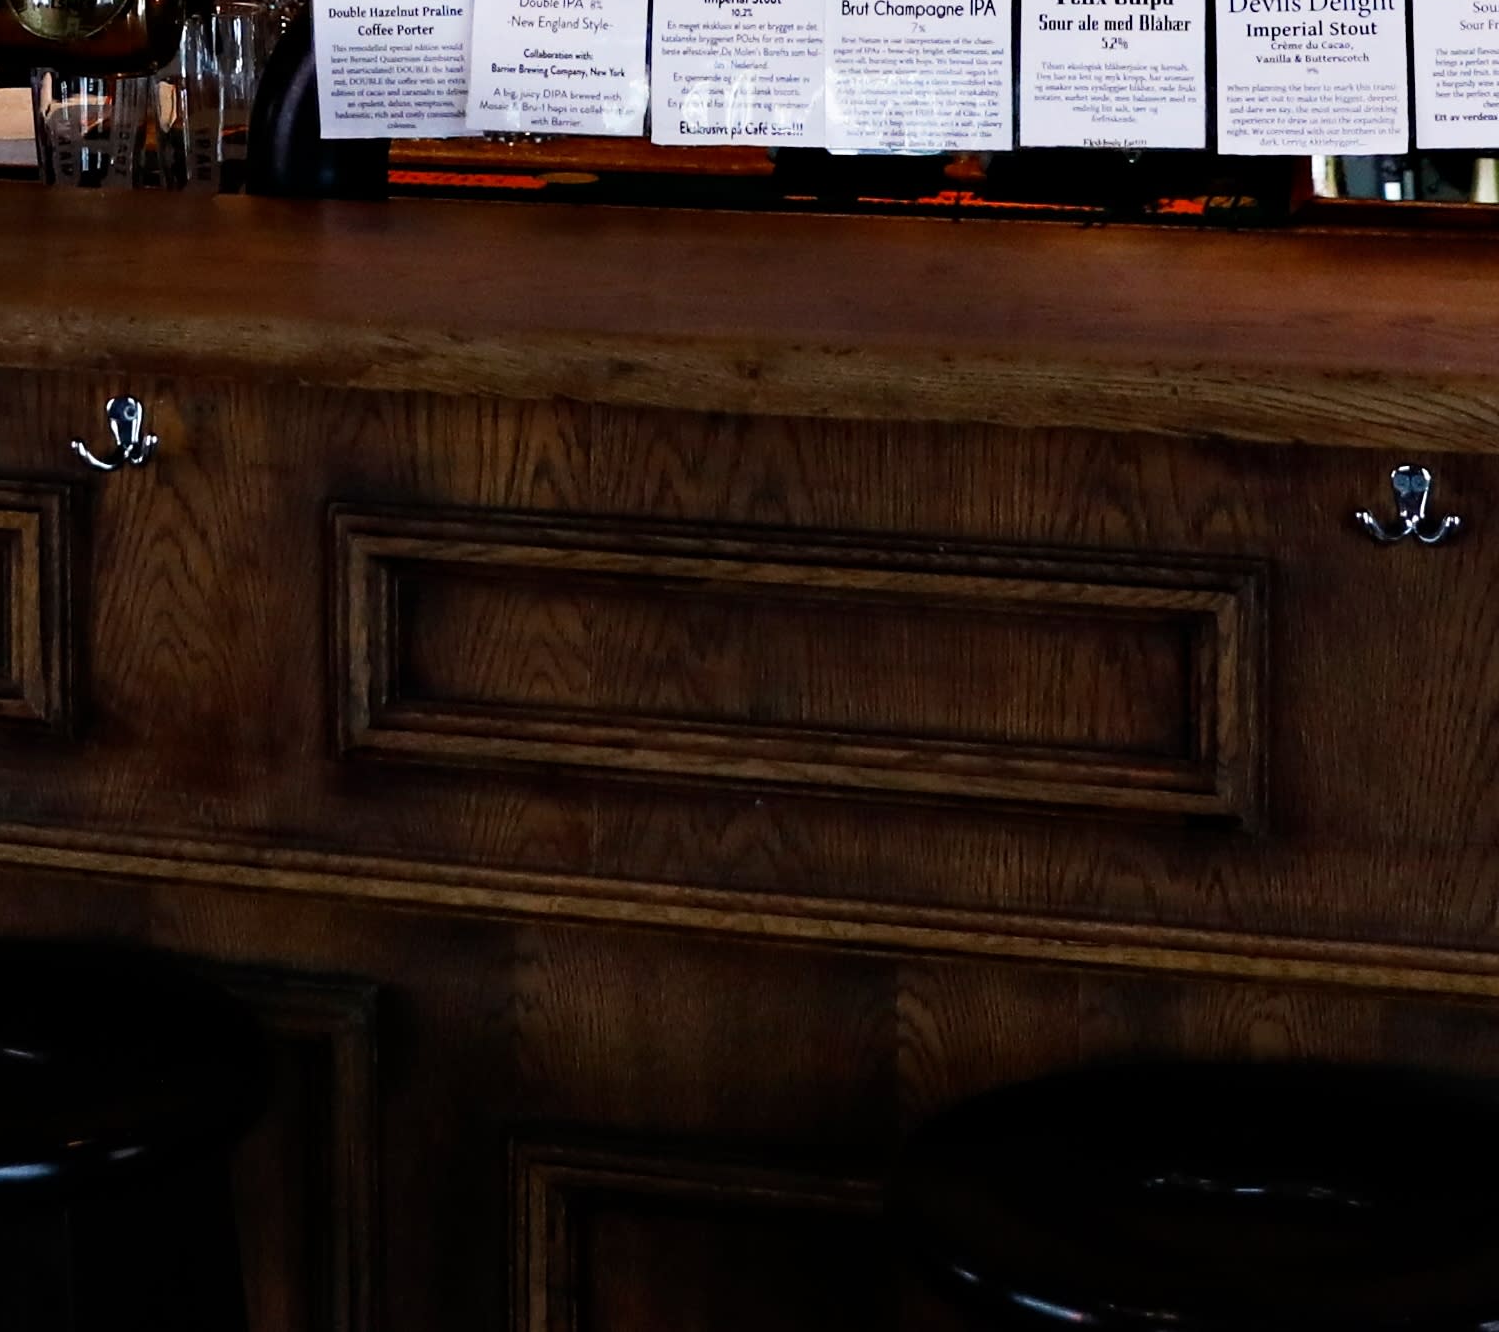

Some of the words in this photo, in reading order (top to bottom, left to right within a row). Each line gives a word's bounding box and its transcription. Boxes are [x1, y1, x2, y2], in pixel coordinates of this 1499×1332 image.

[329, 7, 366, 18] Double
[370, 6, 419, 17] Hazelnut
[423, 5, 463, 17] Praline
[842, 0, 869, 16] Brut
[874, 1, 963, 19] Champagne
[970, 0, 996, 17] IPA
[358, 23, 394, 36] Coffee
[397, 24, 434, 35] Porter
[538, 16, 579, 30] England
[1038, 14, 1074, 32] Sour
[1078, 15, 1099, 32] ale
[1104, 14, 1133, 32] med
[1138, 13, 1191, 32] Blåbær
[1246, 21, 1323, 40] Imperial
[1330, 22, 1377, 35] Stout
[1256, 55, 1291, 63] Vanilla
[1305, 53, 1369, 63] Butterscotch
